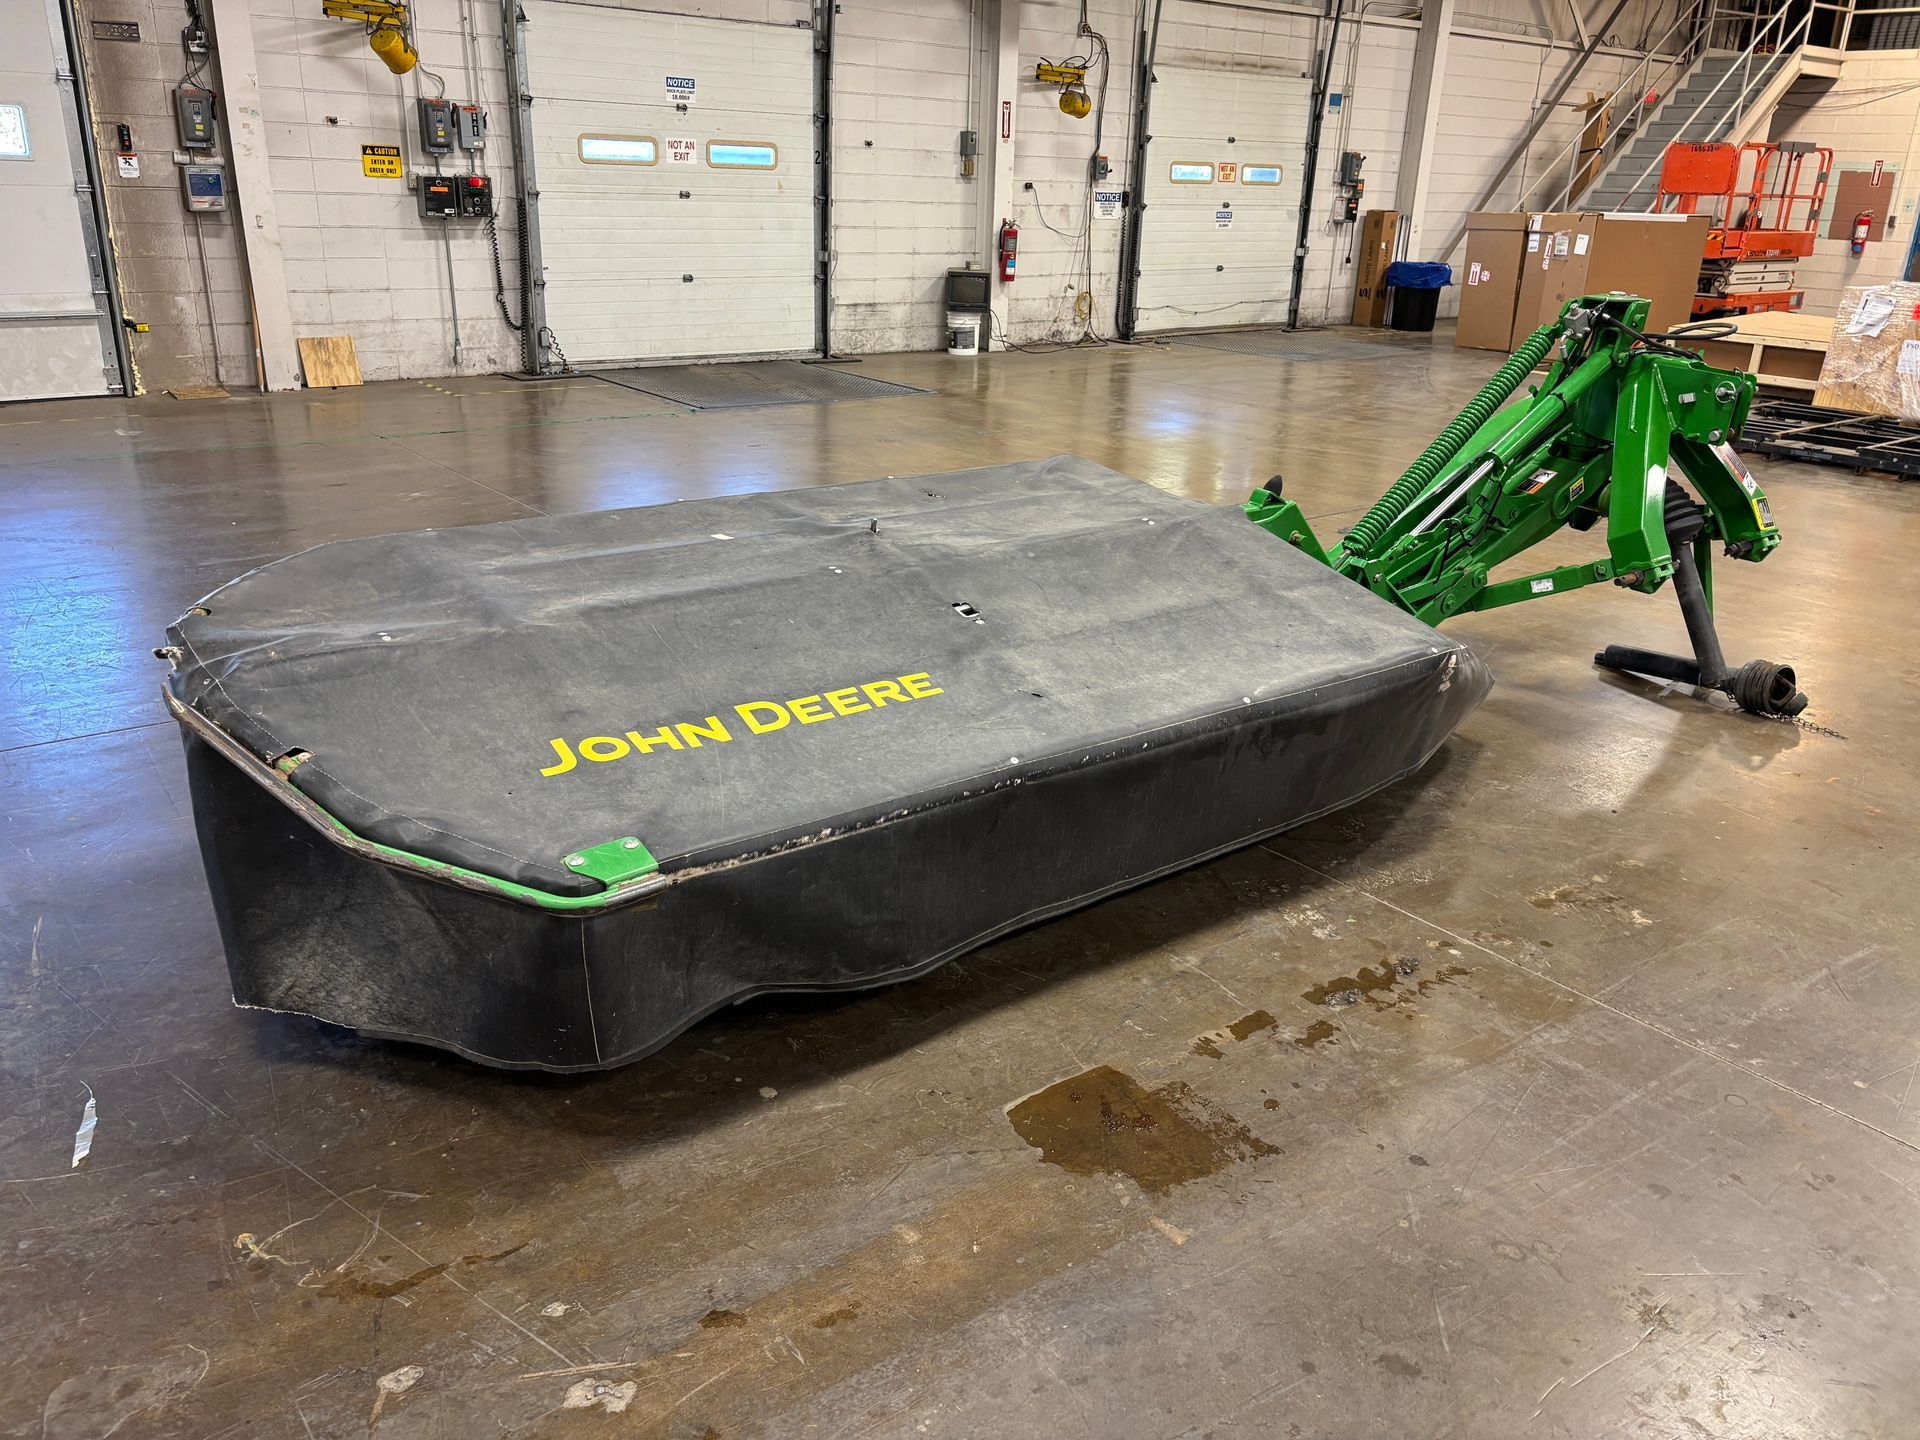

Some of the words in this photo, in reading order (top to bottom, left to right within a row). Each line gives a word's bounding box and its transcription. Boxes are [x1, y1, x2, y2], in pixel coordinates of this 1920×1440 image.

[667, 78, 694, 88] NOTICE
[668, 140, 682, 150] NOT
[684, 141, 695, 150] AN
[374, 147, 397, 156] CAUTION
[673, 152, 690, 161] EXIT
[814, 150, 821, 165] 2
[1096, 193, 1120, 201] NOTICE
[540, 715, 733, 777] JOHN
[734, 672, 945, 735] DEERE
